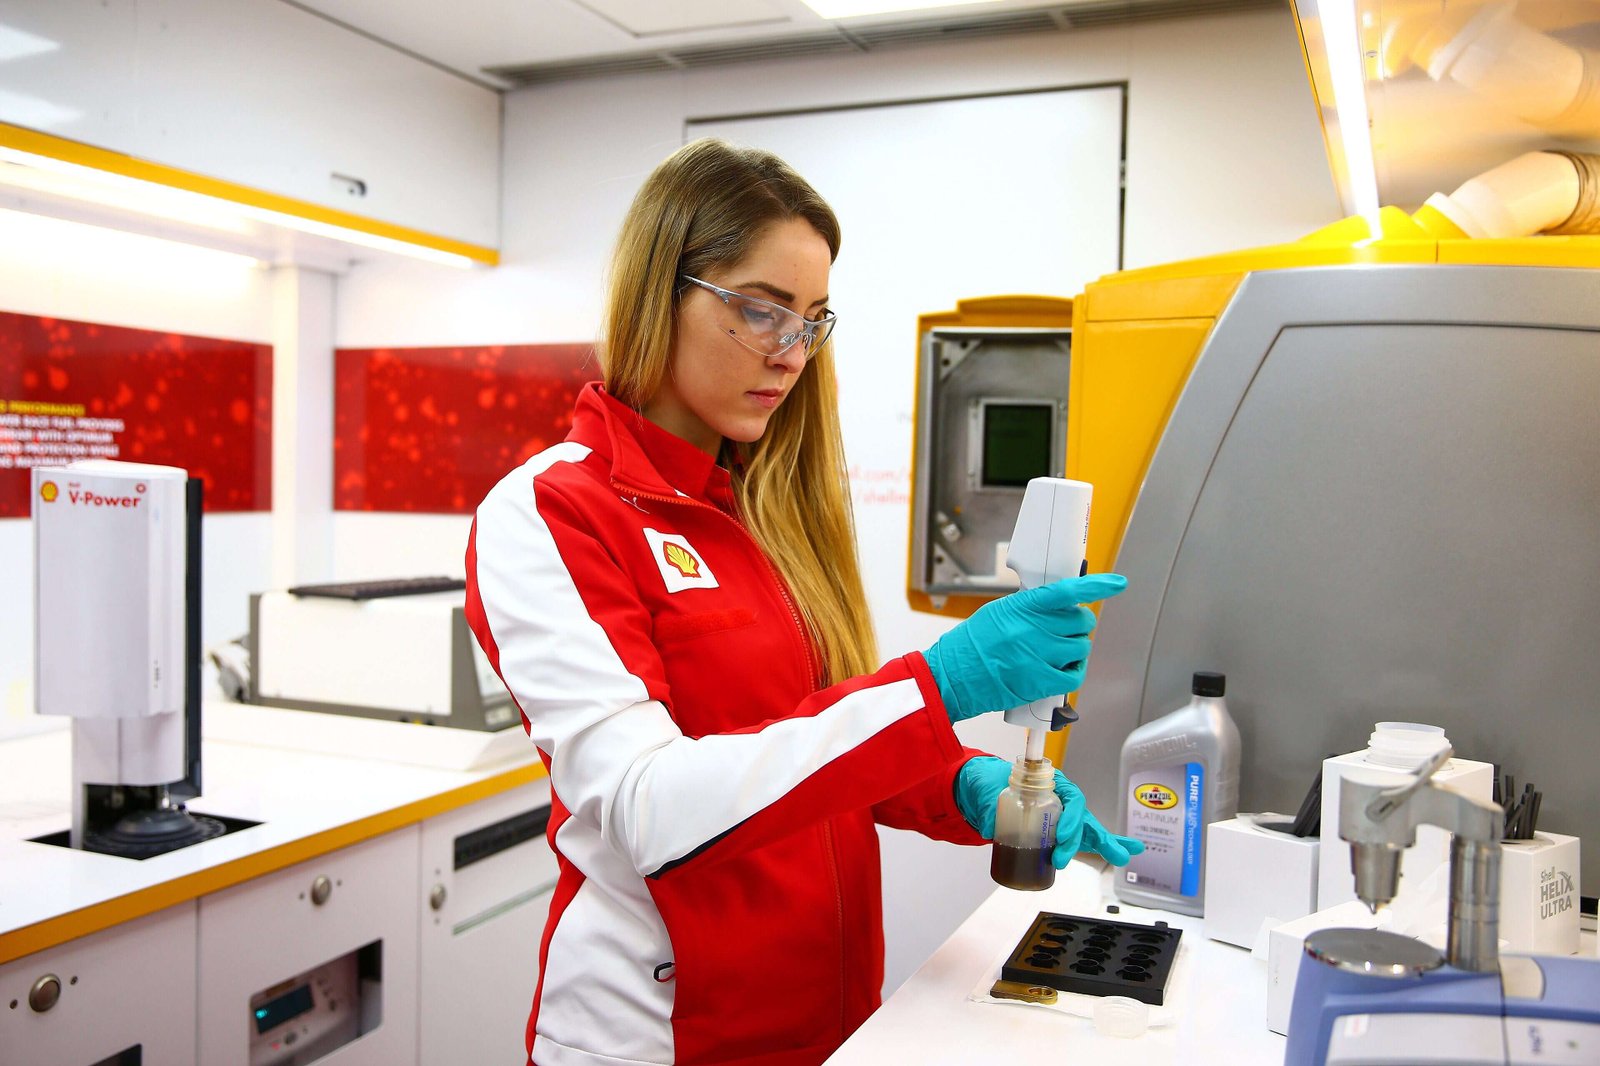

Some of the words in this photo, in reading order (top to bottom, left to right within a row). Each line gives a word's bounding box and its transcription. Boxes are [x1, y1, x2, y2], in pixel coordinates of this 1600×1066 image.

[68, 490, 142, 508] V-Power
[1140, 791, 1172, 801] PENNZOIL
[1132, 809, 1179, 824] PLATINUM
[1540, 866, 1556, 884] Shell
[1540, 874, 1574, 903] HELIX
[1540, 895, 1573, 920] ULTRA
